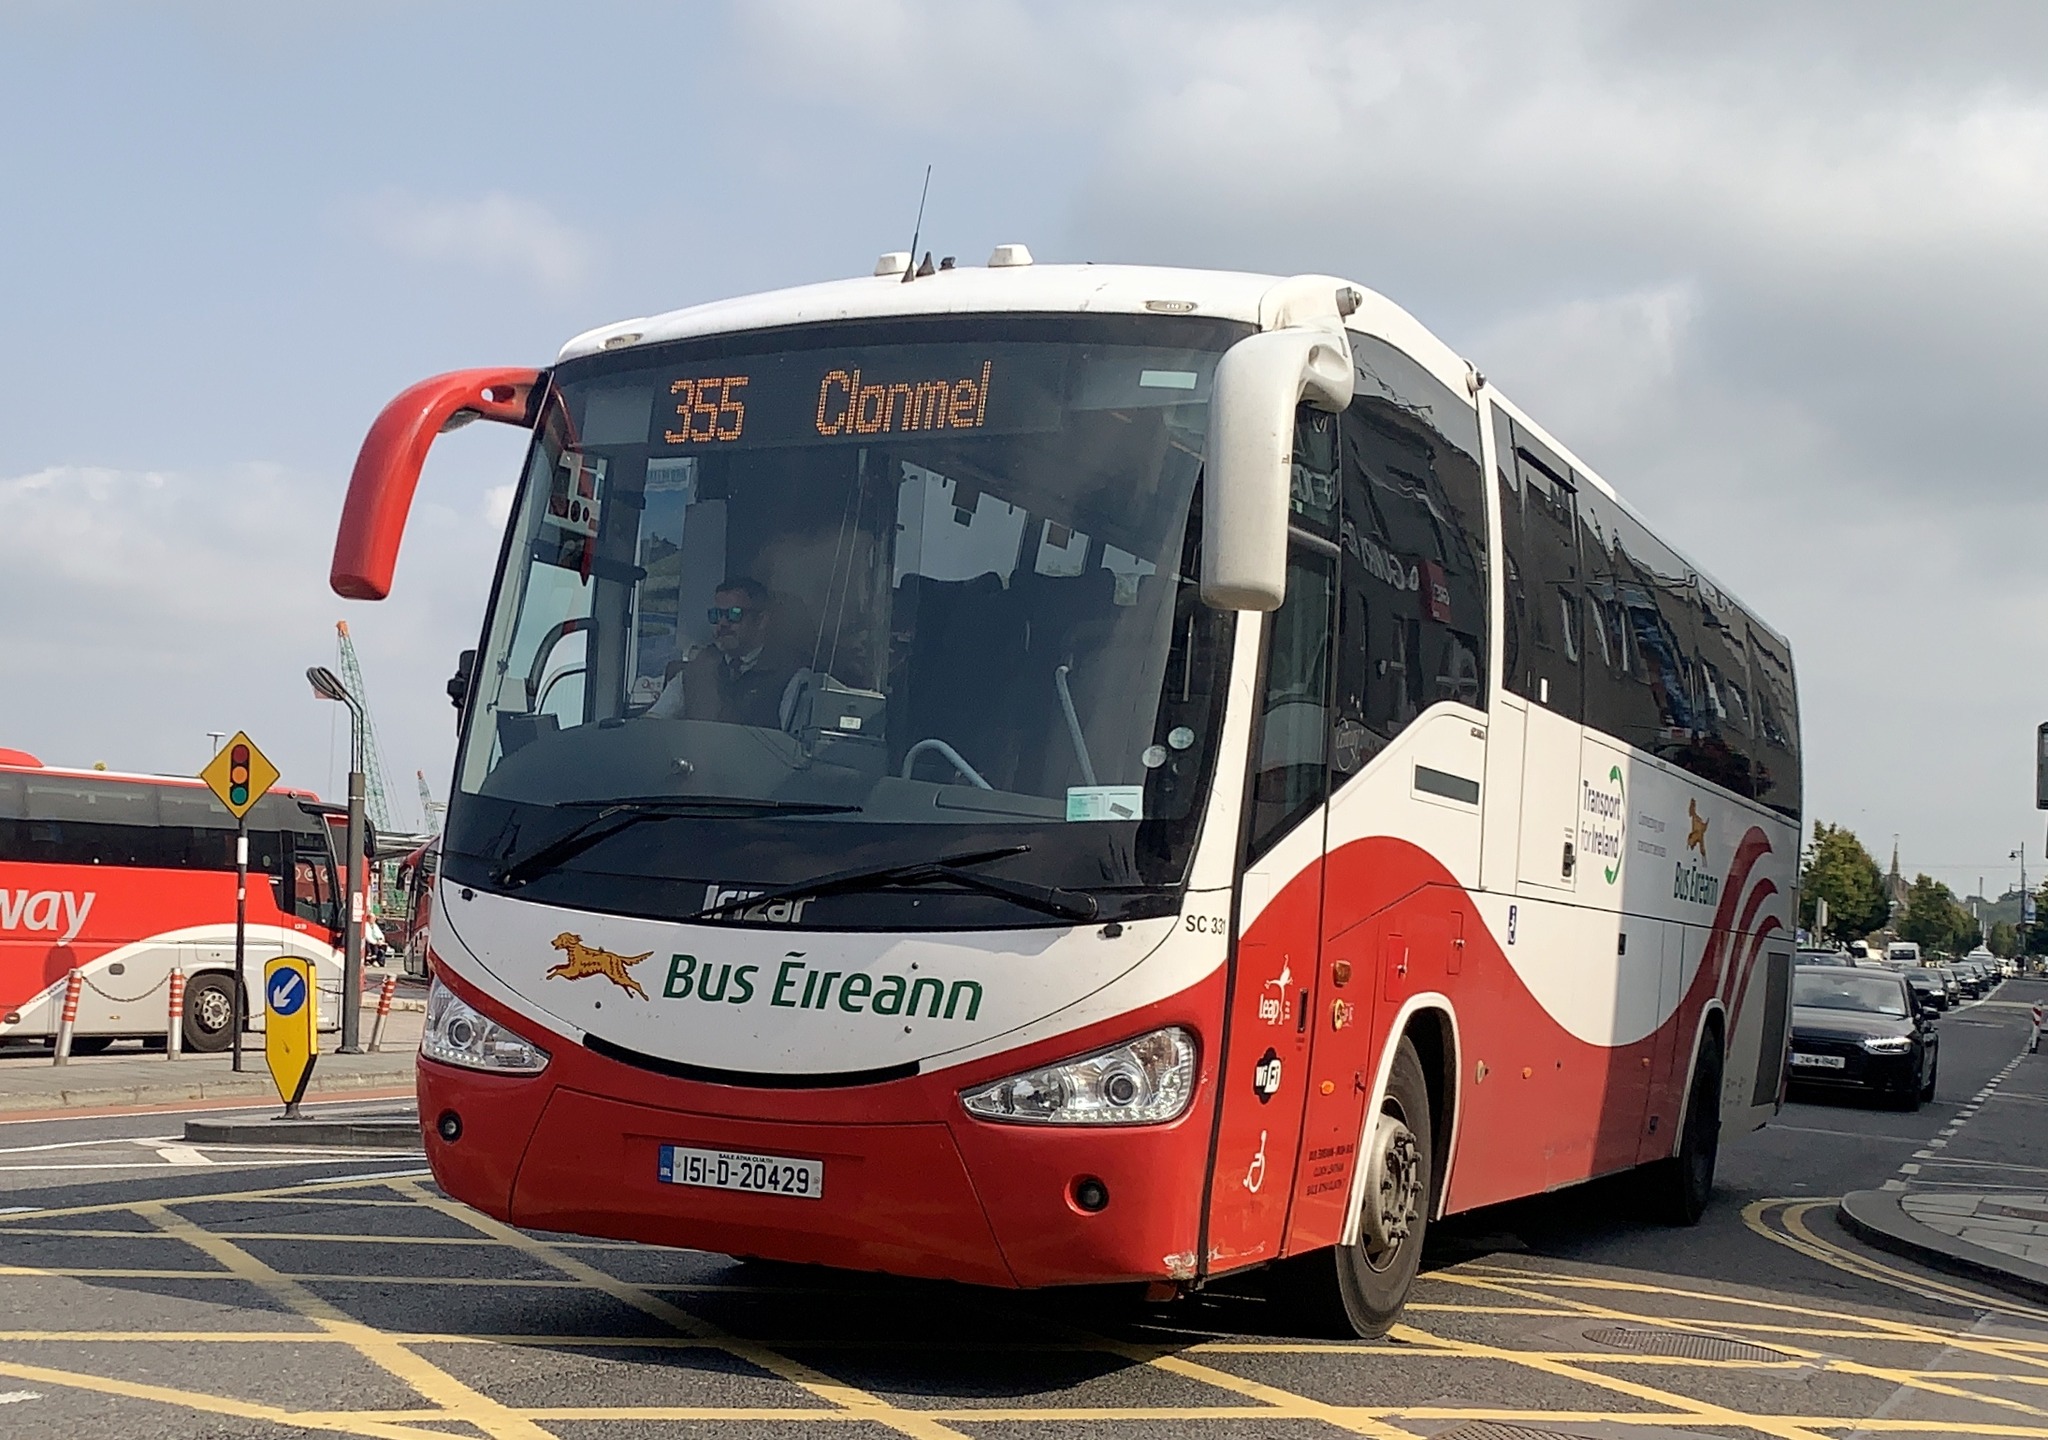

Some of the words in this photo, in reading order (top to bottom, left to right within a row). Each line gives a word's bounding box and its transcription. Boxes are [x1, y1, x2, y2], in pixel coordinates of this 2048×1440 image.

[664, 376, 750, 444] 355
[815, 359, 993, 436] Clonmel
[1583, 779, 1621, 822] Transport
[1591, 823, 1620, 859] Ireland
[1185, 914, 1207, 933] SC
[662, 953, 760, 1005] Bus
[769, 950, 984, 1022] Éireann
[682, 1155, 810, 1195] 151-D-20429
